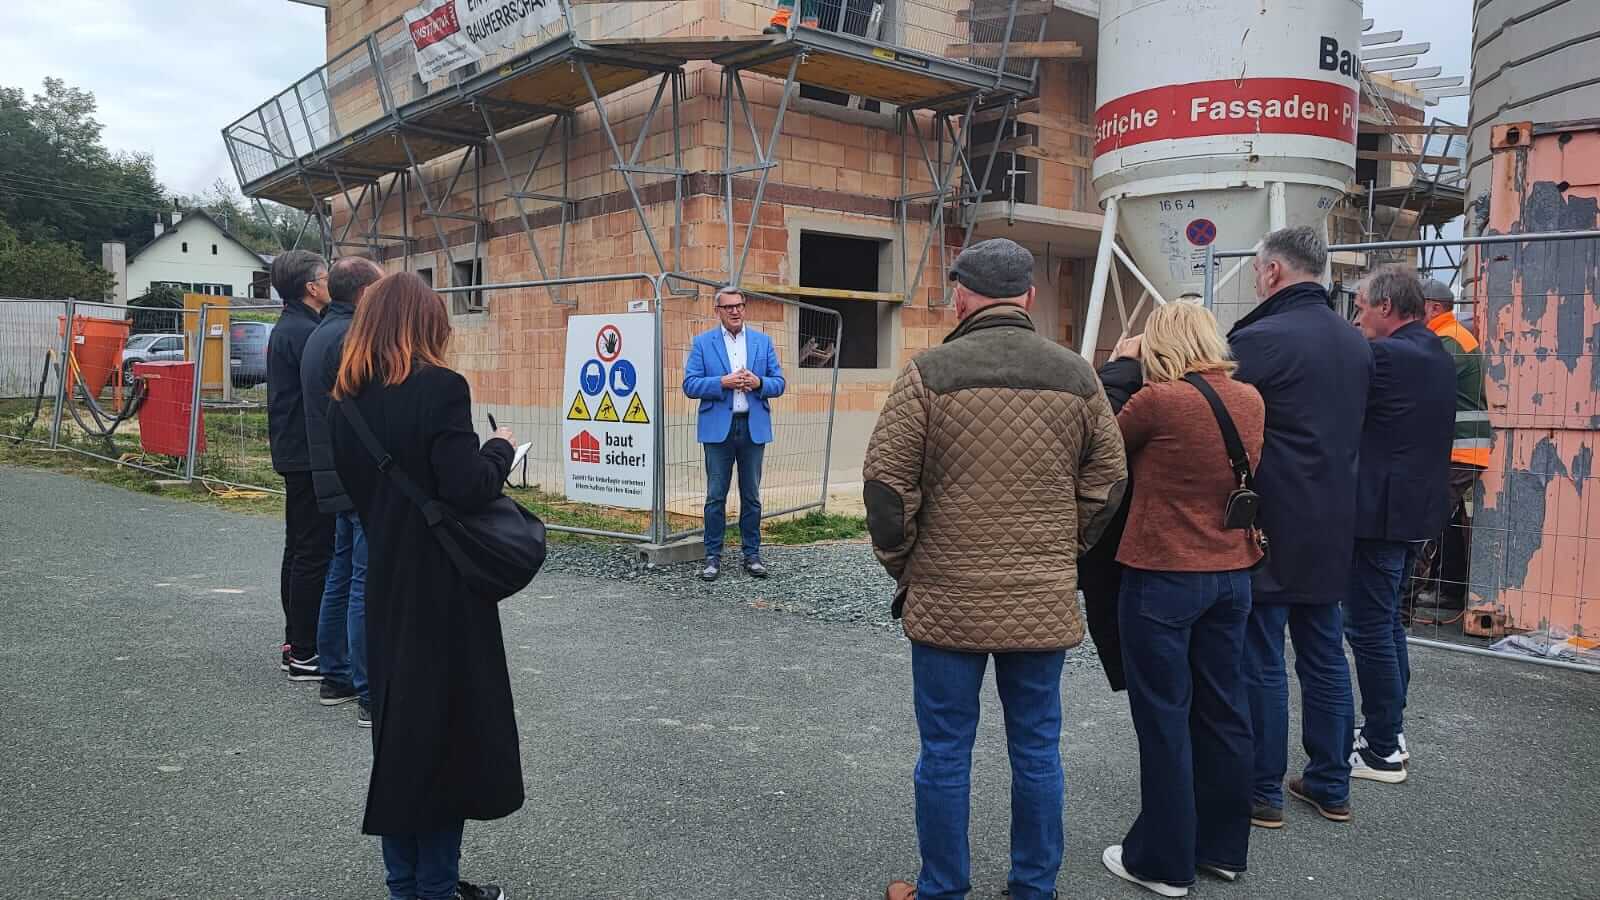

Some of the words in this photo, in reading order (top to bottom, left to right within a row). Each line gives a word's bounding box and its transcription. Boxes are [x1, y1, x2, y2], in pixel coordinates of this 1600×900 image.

[466, 0, 552, 44] BAUHERRSCHA
[1095, 108, 1158, 146] striche
[1190, 95, 1329, 122] Fassaden
[605, 431, 634, 448] baut
[605, 450, 646, 468] sicher!
